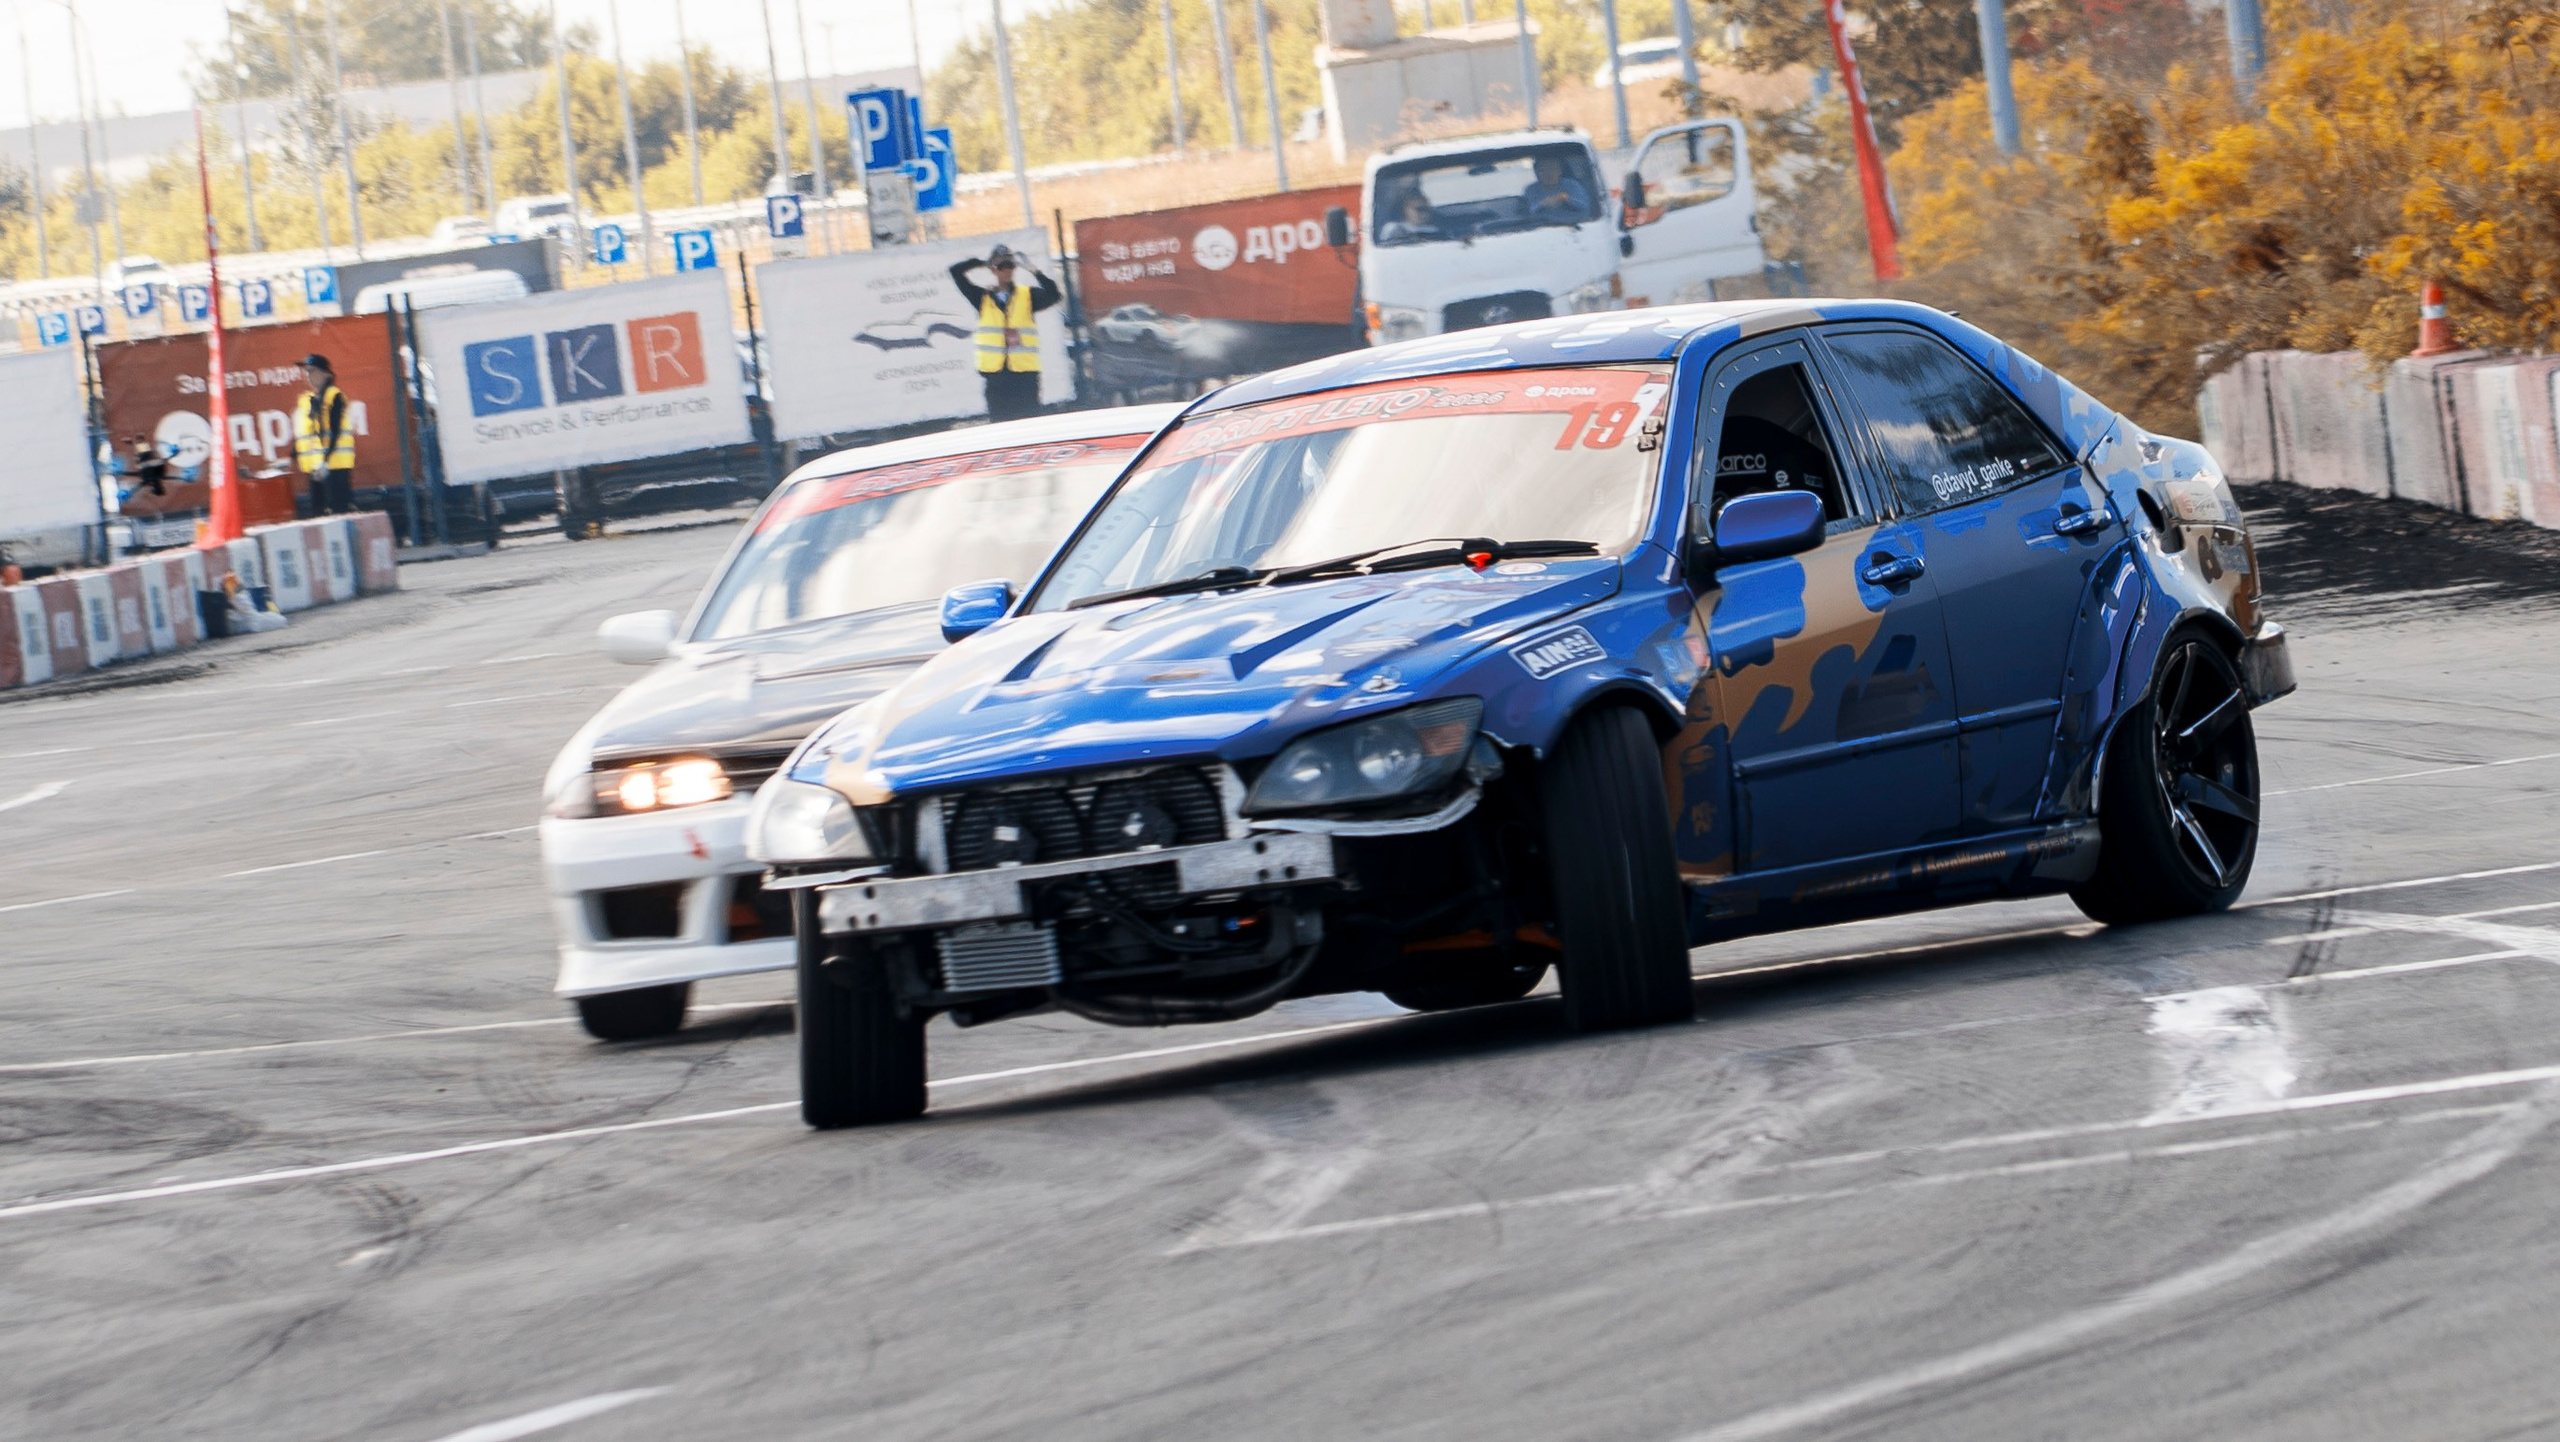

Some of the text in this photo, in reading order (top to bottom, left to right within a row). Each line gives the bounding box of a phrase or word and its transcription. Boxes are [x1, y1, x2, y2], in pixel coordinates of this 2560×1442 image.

[859, 98, 889, 164] P
[774, 199, 799, 235] P
[600, 228, 622, 261] P
[678, 233, 710, 269] P
[1101, 236, 1181, 262] За авто
[126, 284, 150, 316] P
[243, 282, 268, 316] P
[307, 268, 331, 302] P
[80, 307, 102, 331] P
[185, 287, 208, 320] P
[224, 369, 258, 389] вто
[481, 325, 690, 405] SKR
[1308, 387, 1437, 424] LETO
[1545, 385, 1597, 398] дром
[474, 416, 554, 444] Service
[558, 413, 577, 431] &
[1554, 401, 1640, 450] 19
[1717, 453, 1767, 472] arco
[1932, 456, 2015, 501] @davyd_ganke
